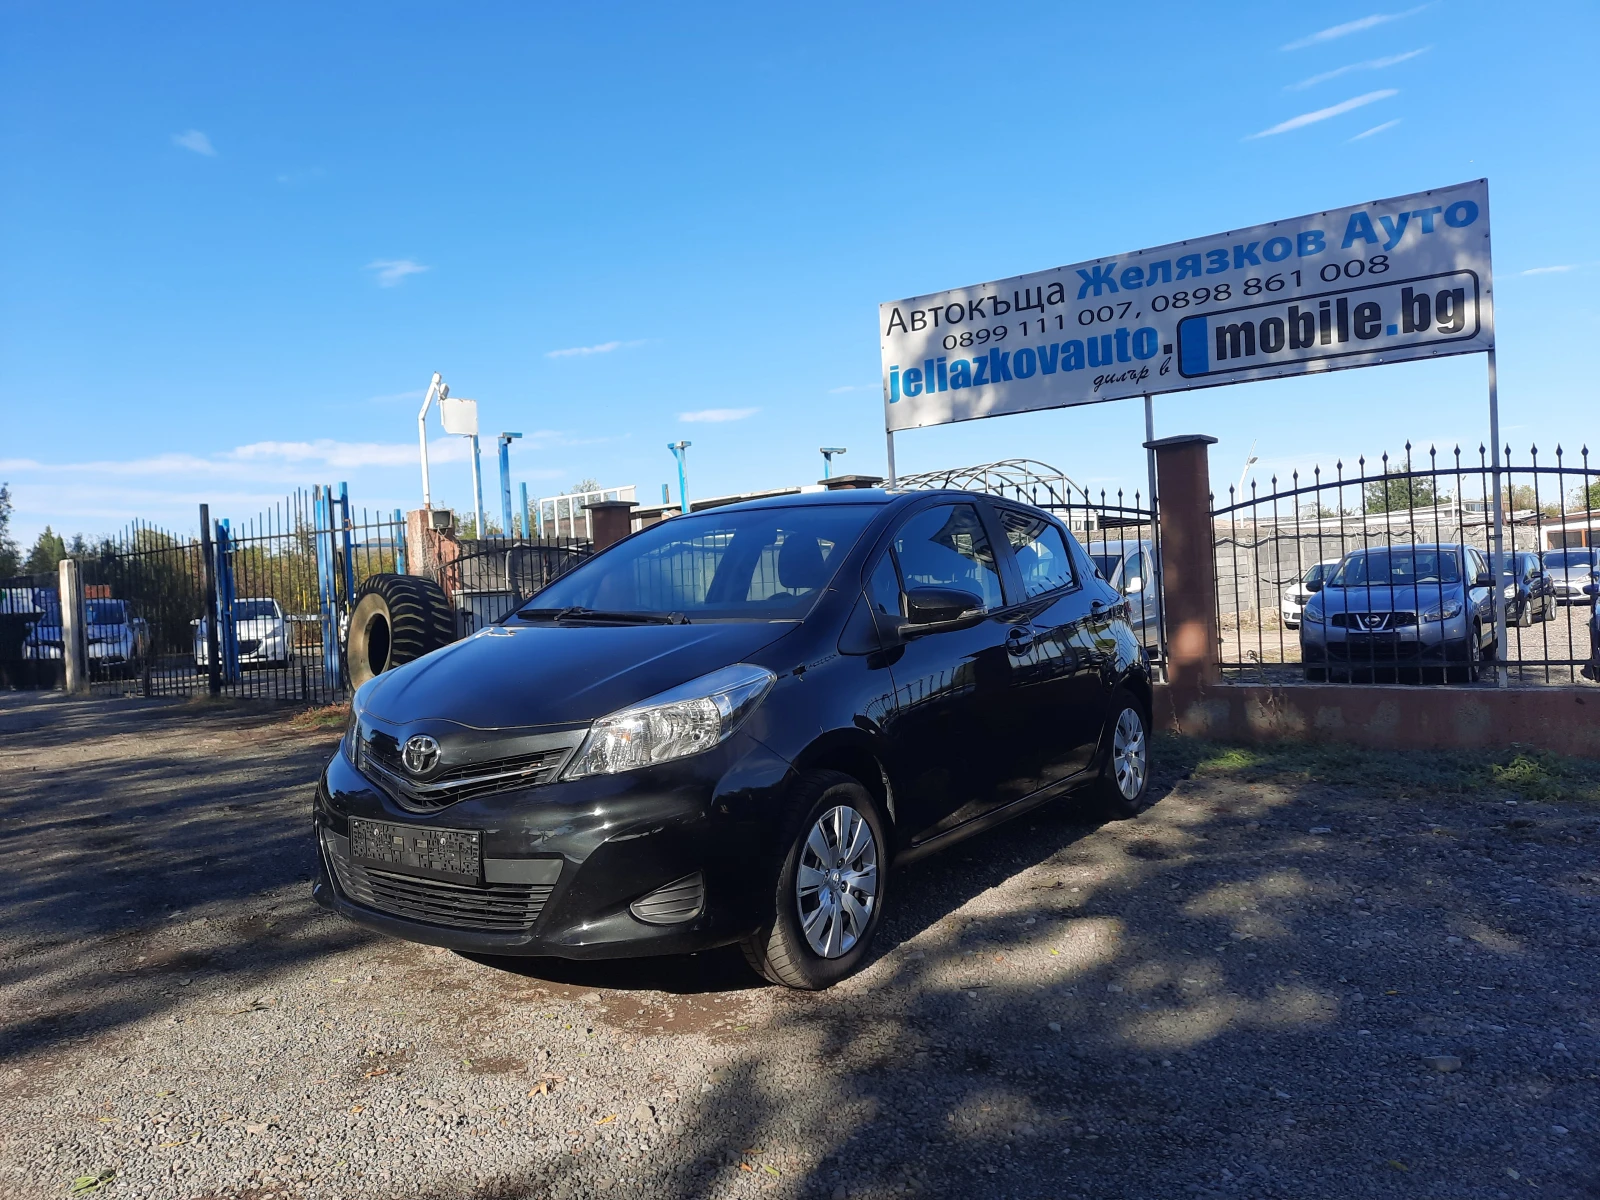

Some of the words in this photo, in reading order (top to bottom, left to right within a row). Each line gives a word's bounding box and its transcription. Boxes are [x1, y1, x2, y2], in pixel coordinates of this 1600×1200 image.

[886, 282, 1065, 336] Автокъща
[1077, 229, 1327, 300] Желязков
[1340, 200, 1480, 252] Ауто
[943, 325, 1008, 350] 0899
[1019, 314, 1064, 337] 111
[1078, 301, 1142, 326] 007,
[1151, 283, 1232, 313] 0898
[1243, 269, 1302, 297] 861
[1320, 254, 1391, 283] 008
[1215, 287, 1466, 361] mobile.bg
